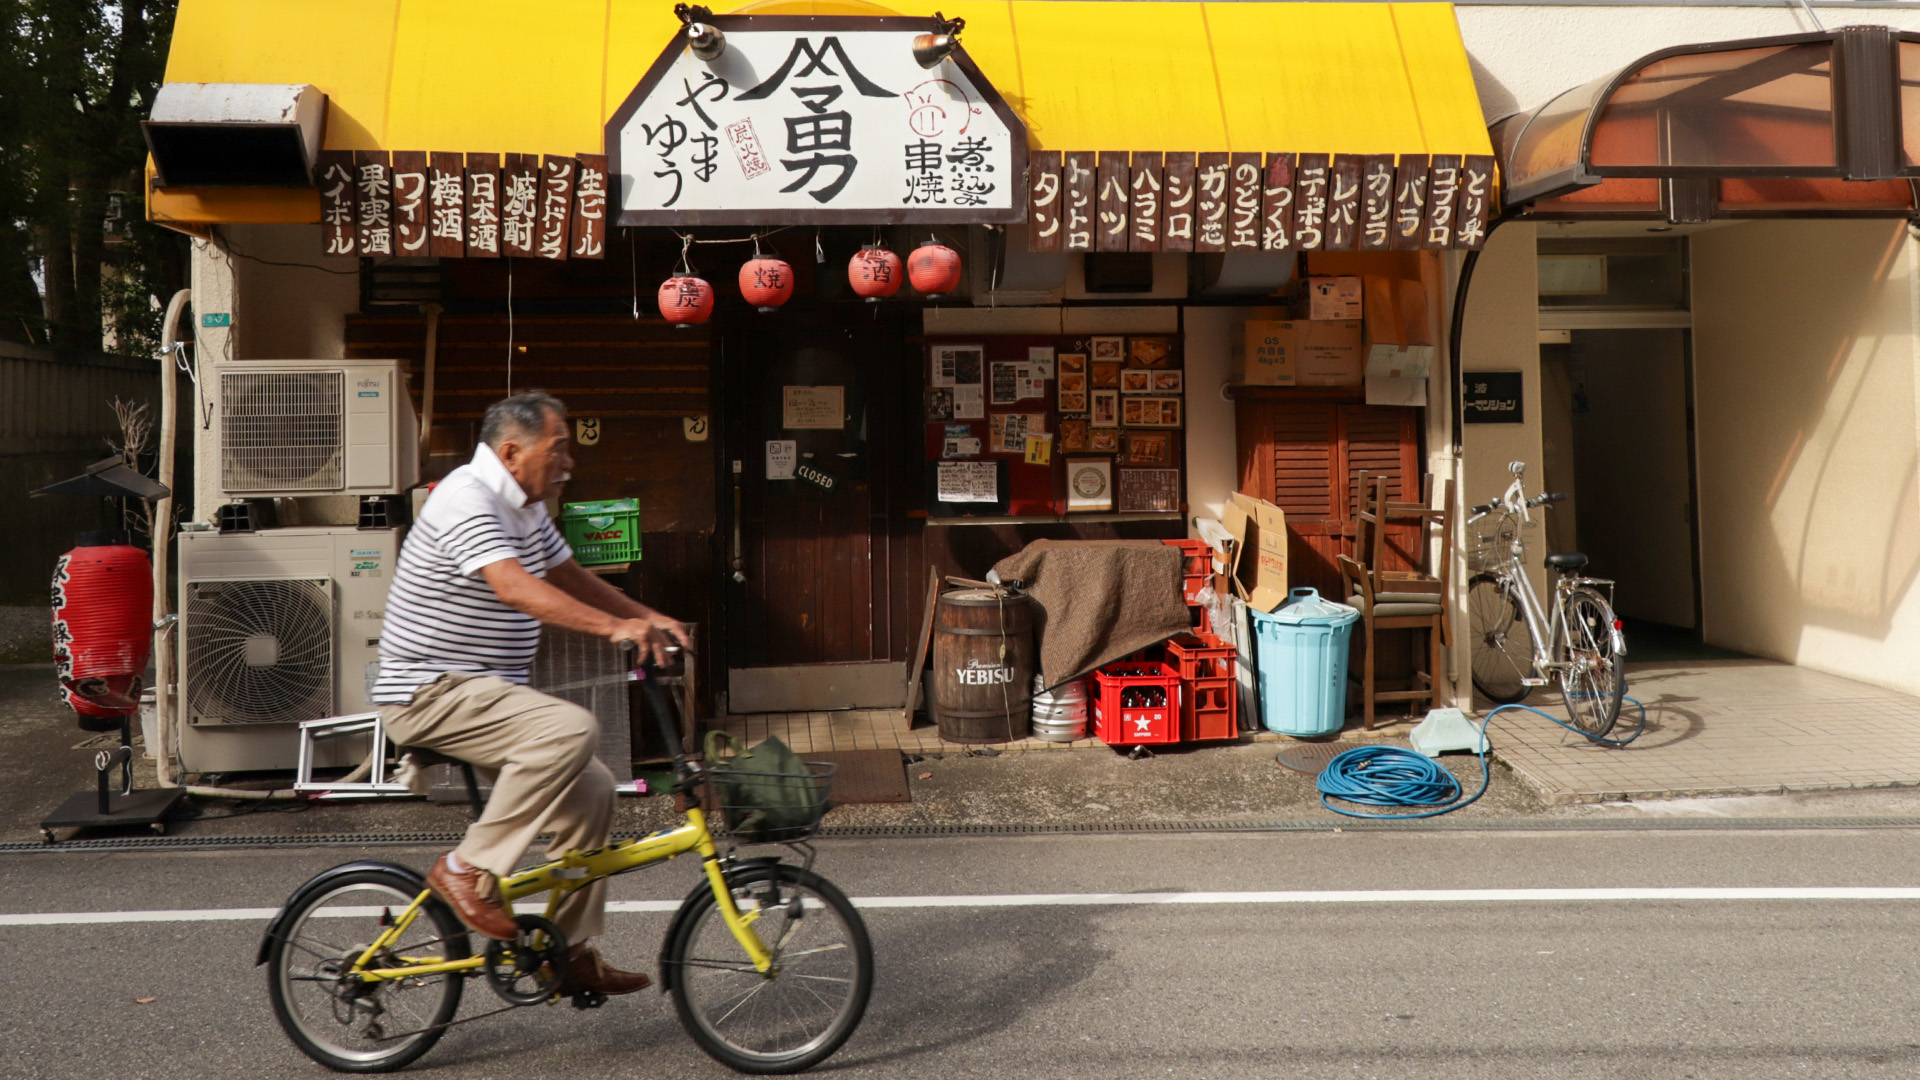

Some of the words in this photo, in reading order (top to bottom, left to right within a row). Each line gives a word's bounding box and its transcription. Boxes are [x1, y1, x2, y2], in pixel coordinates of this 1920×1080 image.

[733, 124, 765, 174] 炭火焼
[902, 138, 947, 205] 串焼
[945, 135, 996, 207] 煮込み
[324, 163, 355, 255] ハイボール
[357, 163, 391, 255] 果実酒
[394, 172, 427, 251] ワイン
[429, 169, 464, 242] 梅酒
[469, 173, 499, 254] 日本酒
[503, 170, 537, 252] 焼酎
[539, 161, 571, 259] ソフトドリンク
[575, 168, 606, 256] 生ビール
[1033, 171, 1060, 238] タン
[1068, 157, 1091, 249] トントロ
[1100, 175, 1128, 235] ハツ
[1132, 168, 1161, 242] ハラミ
[1168, 175, 1194, 239] シロ
[1200, 163, 1229, 245] ガツ芯
[1231, 163, 1260, 247] のどブエ
[1262, 186, 1293, 250] つくね
[1329, 173, 1359, 245] レバー
[1365, 163, 1391, 246] カシラ
[1397, 175, 1427, 237] バラ
[1428, 168, 1459, 247] コブクロ
[1458, 168, 1487, 246] とり身
[675, 282, 700, 308] 炭
[754, 267, 785, 289] 焼
[863, 259, 892, 283] 酒
[1264, 336, 1279, 346] GS
[357, 380, 380, 388] FUJITSU
[798, 465, 833, 488] CLOSED
[956, 666, 1015, 686] YEBISU
